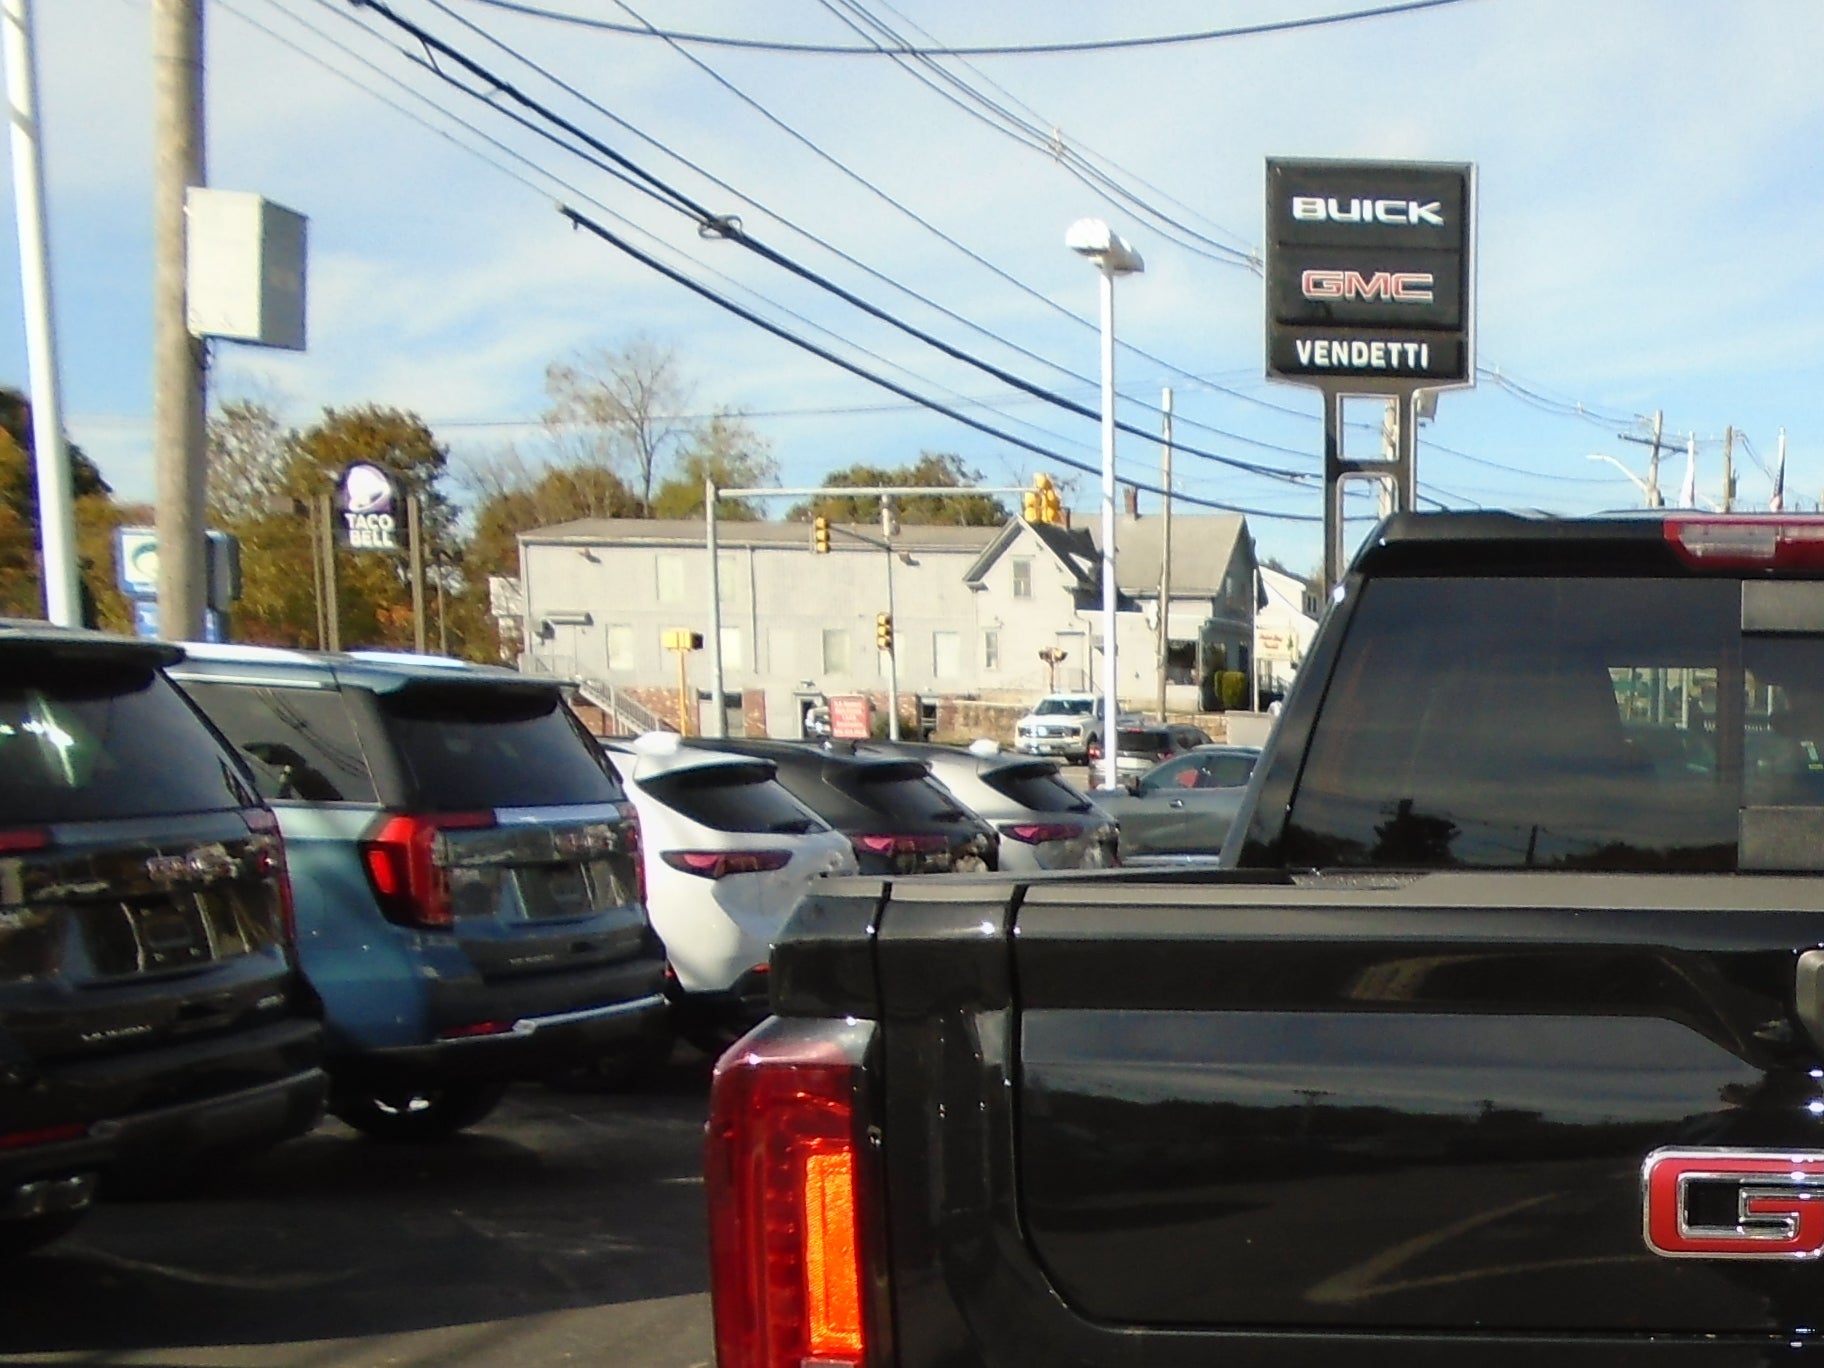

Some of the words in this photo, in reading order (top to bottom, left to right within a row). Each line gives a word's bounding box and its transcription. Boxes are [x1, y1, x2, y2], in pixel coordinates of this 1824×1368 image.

[1293, 196, 1444, 226] BUICK
[1302, 269, 1433, 304] GMC
[1296, 339, 1428, 370] VENDETTI
[344, 513, 395, 531] TACO
[349, 529, 395, 548] BELL
